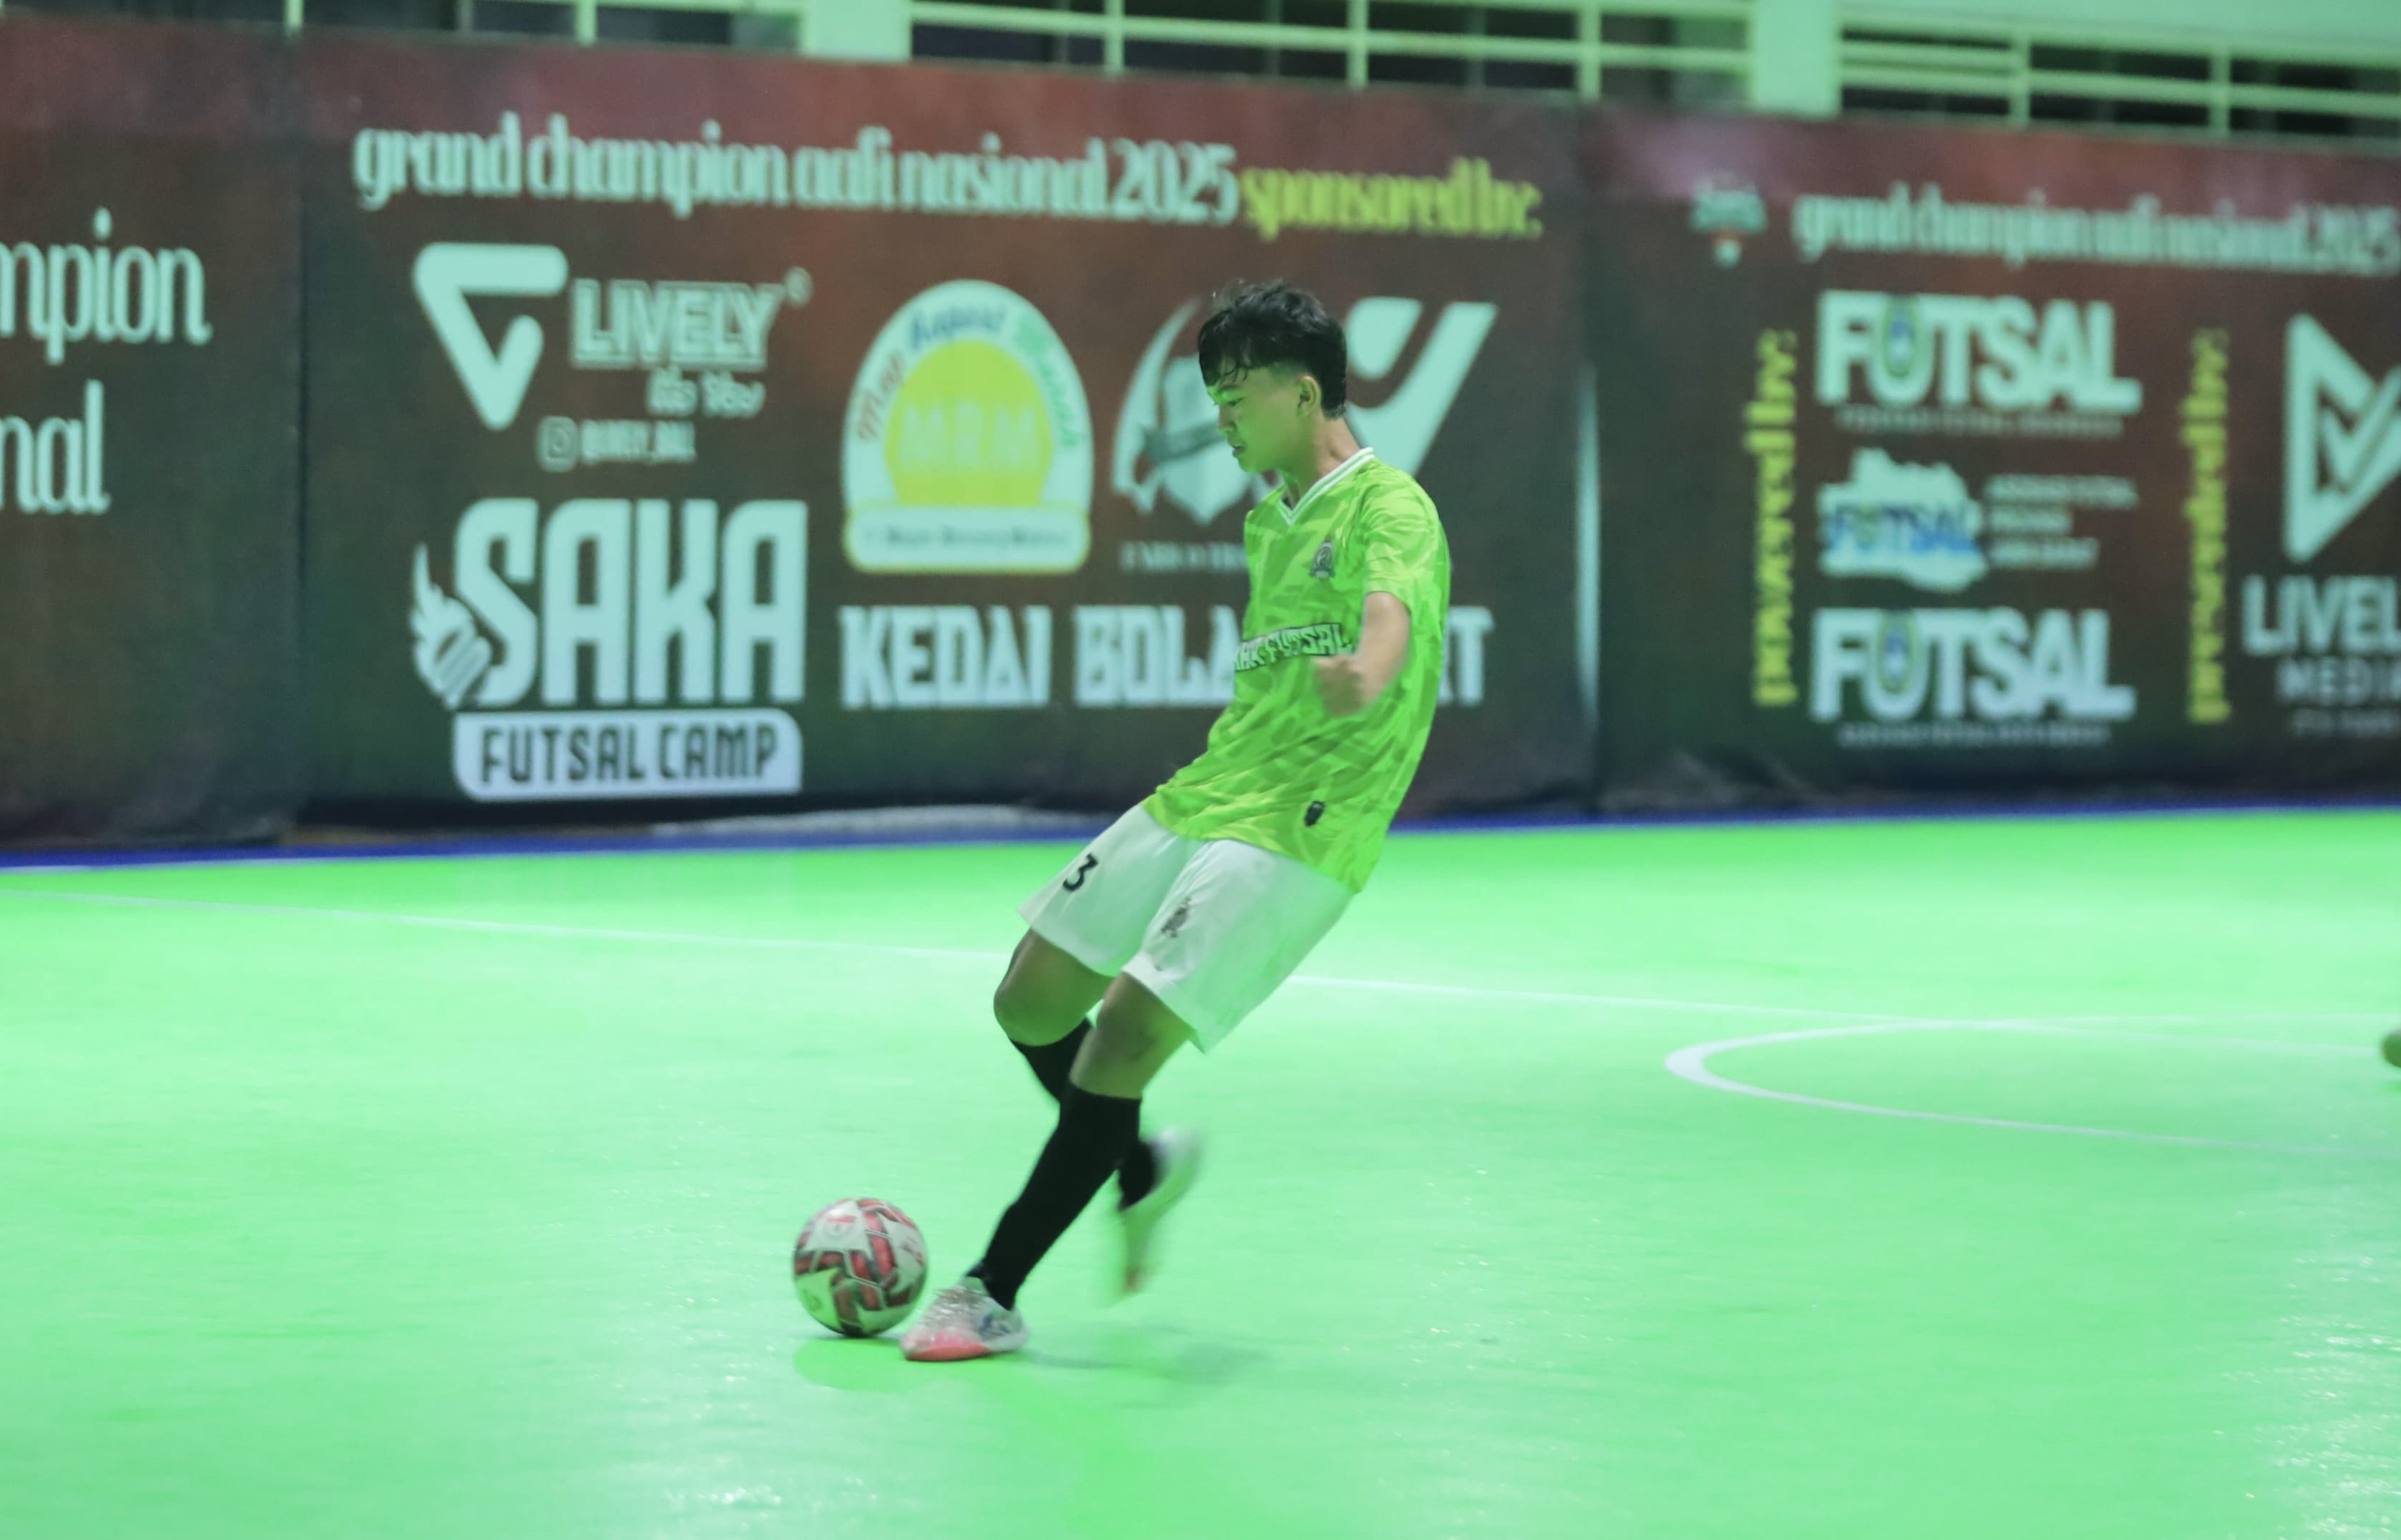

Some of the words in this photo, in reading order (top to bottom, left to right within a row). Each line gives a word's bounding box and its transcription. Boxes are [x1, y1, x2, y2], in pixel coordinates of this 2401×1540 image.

[351, 109, 522, 211] grand
[527, 111, 790, 220] champion
[898, 131, 1109, 218] nasional
[1110, 138, 1240, 226] 2025
[1791, 179, 1911, 264] grand
[1912, 180, 2091, 269] champion
[569, 277, 788, 373] LIVELY
[1815, 291, 2143, 413] FUTSAL
[452, 496, 808, 706] SAKA
[837, 605, 1053, 708] KEDAI
[1808, 606, 2138, 723] FUTSAL
[480, 724, 647, 784] FUTSAL
[658, 721, 779, 781] CAMP
[1062, 852, 1099, 893] 3
